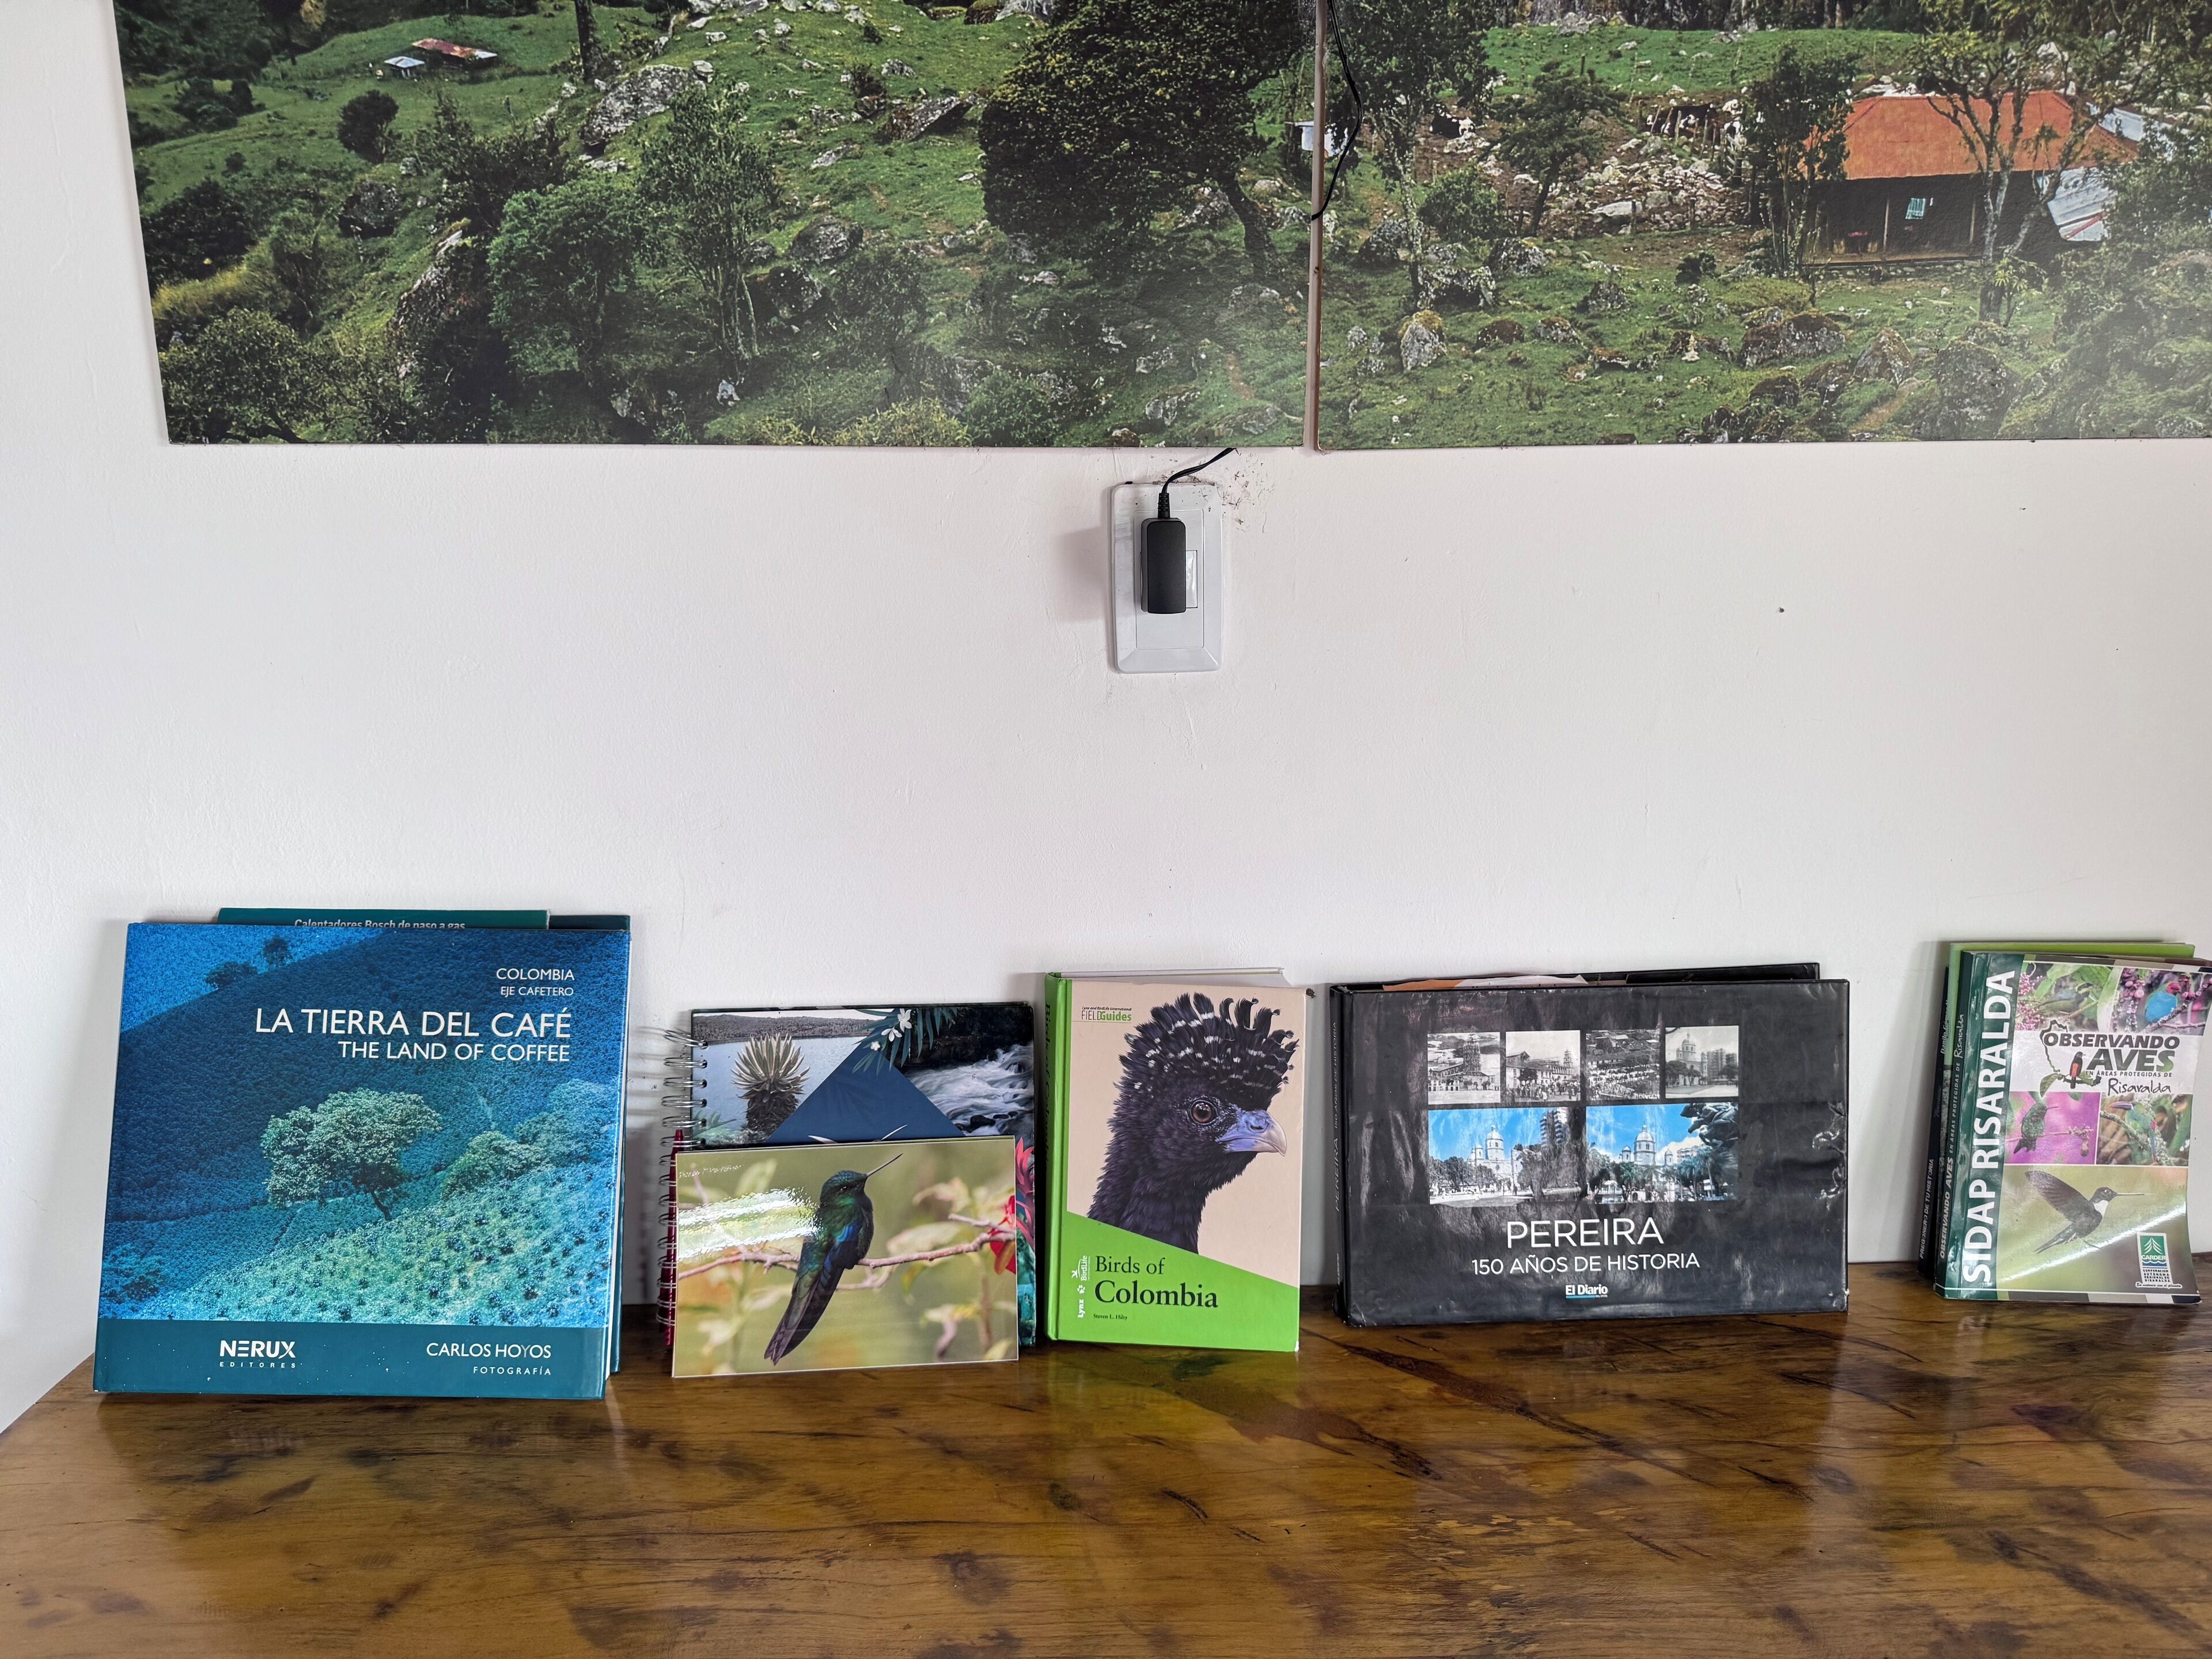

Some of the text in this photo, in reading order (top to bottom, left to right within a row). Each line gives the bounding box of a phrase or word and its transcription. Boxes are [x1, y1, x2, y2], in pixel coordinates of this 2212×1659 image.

[365, 920, 393, 928] Bosch
[398, 920, 411, 928] de
[497, 968, 575, 980] COLOMBIA
[501, 986, 574, 997] EJE CAFETERO
[256, 1007, 571, 1038] LA TIERRA DEL CAFÉ
[1954, 1014, 1964, 1058] Risaralda
[2044, 1032, 2180, 1049] OBSERVANDO
[338, 1041, 570, 1062] THE LAND OF COFFEE
[2086, 1048, 2175, 1073] AVES
[1956, 1062, 1960, 1071] DE
[2108, 1078, 2171, 1096] Risaralda
[1963, 971, 2015, 1283] SIDAP RISARALDA
[1919, 1159, 1934, 1259] PREGONERO DE TU HISTORIA
[1939, 1157, 1953, 1259] OBSERVANDO AVES
[1506, 1217, 1664, 1248] PEREIRA
[1096, 1256, 1140, 1274] Birds
[1146, 1257, 1165, 1275] of
[1472, 1252, 1700, 1275] 150 AÑOS DE HISTORIA
[1095, 1280, 1218, 1308] Colombia
[1566, 1284, 1608, 1295] El Diario
[1077, 1298, 1086, 1318] Lynx
[220, 1340, 296, 1358] NERUX
[426, 1342, 551, 1358] CARLOS HOYOS
[473, 1365, 551, 1376] FOTOGRAFÍA
